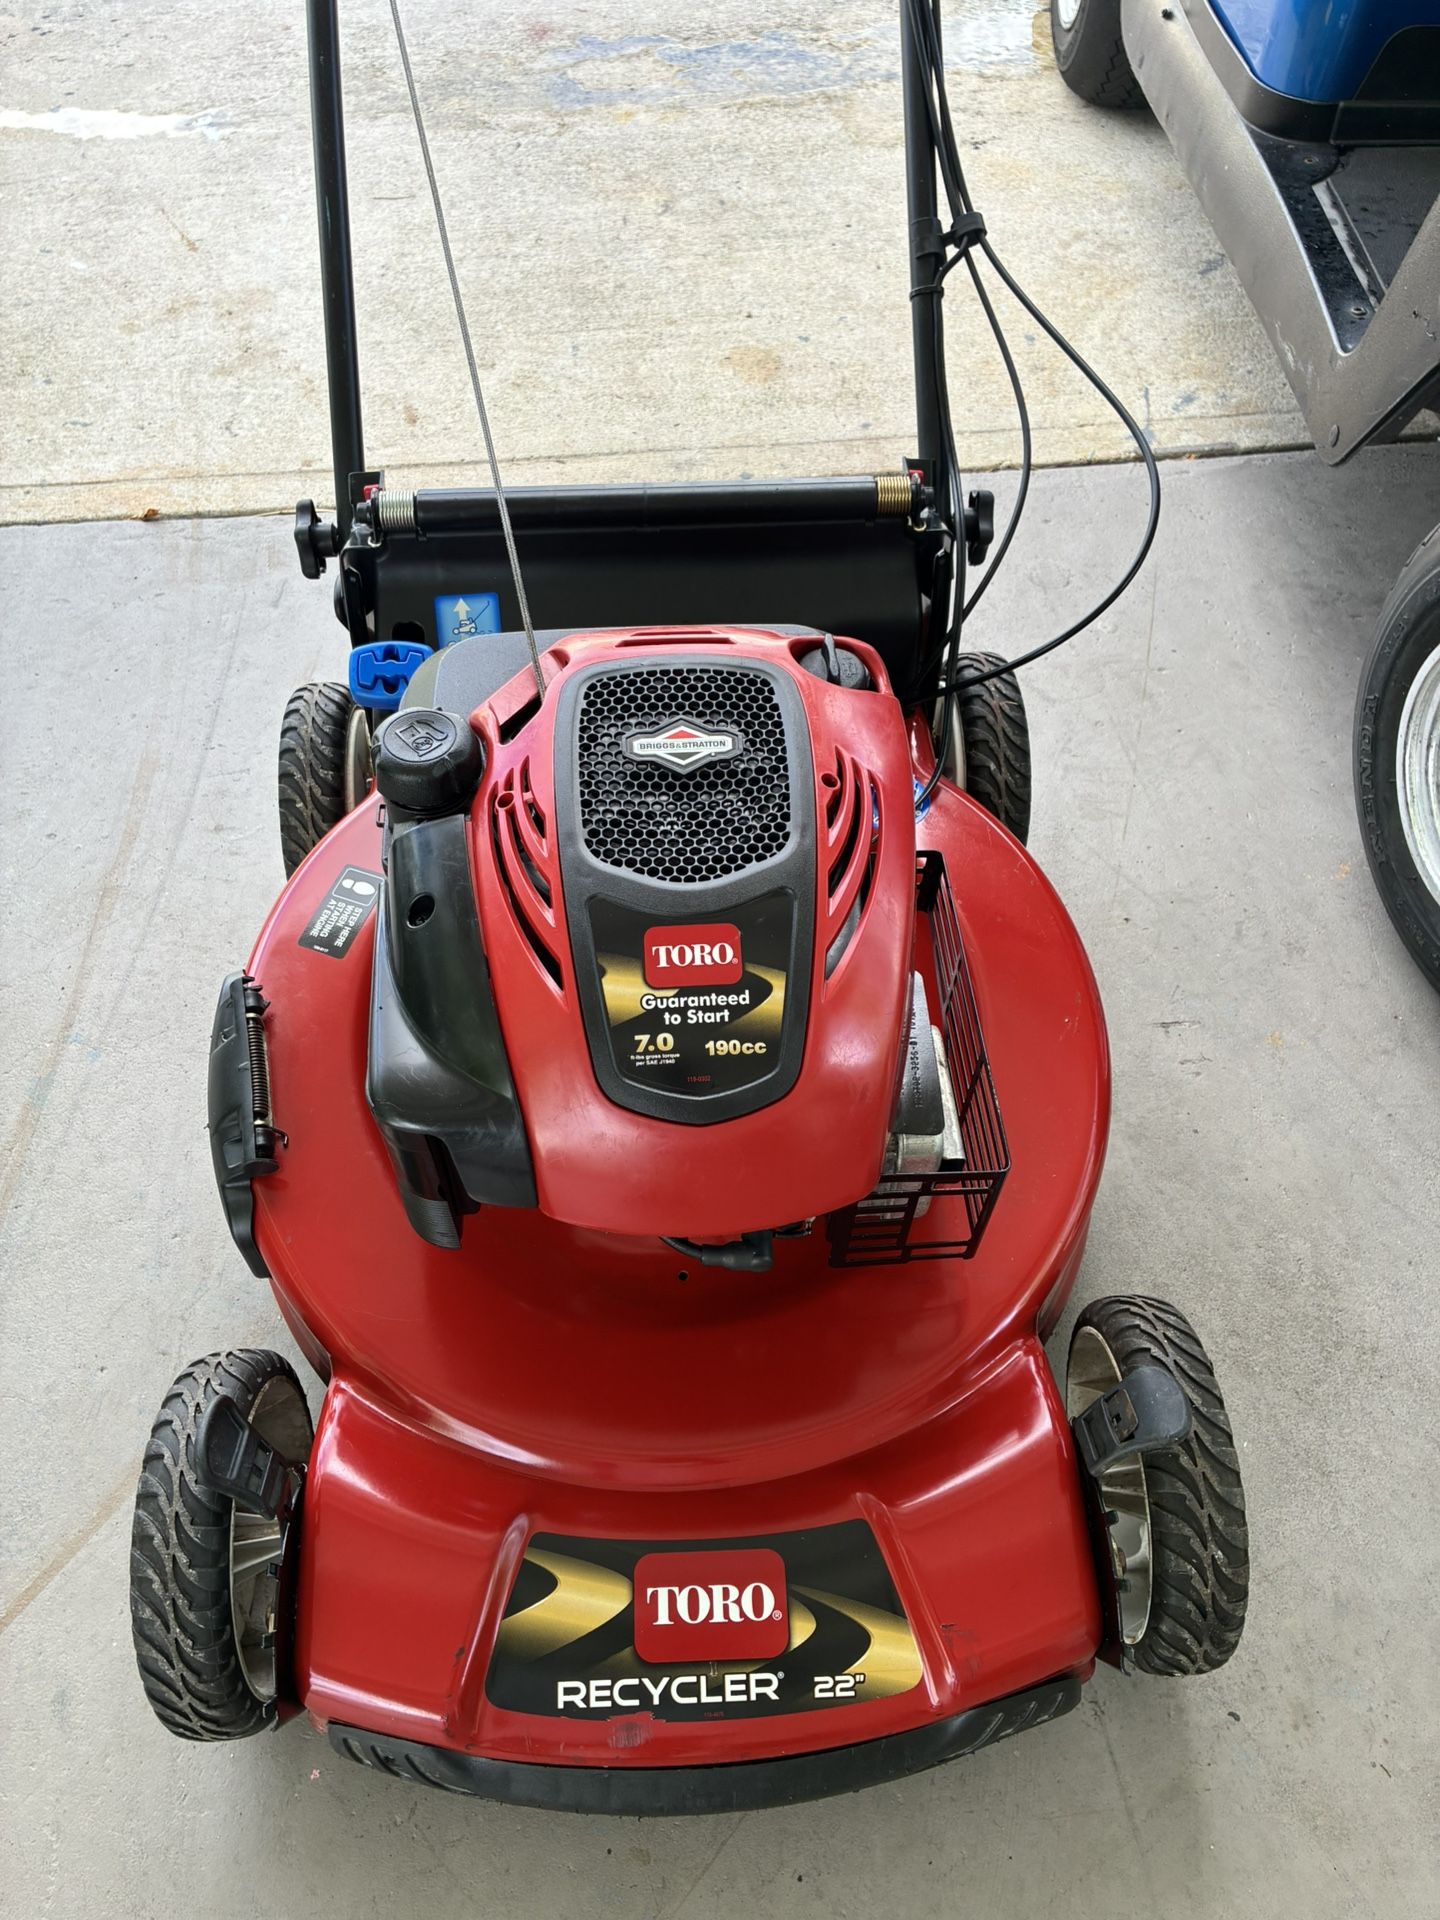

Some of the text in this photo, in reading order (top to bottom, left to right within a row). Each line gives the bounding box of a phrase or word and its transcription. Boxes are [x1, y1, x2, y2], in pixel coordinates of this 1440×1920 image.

[327, 898, 337, 911] AT
[336, 905, 355, 927] WHEN
[309, 909, 332, 938] ENGINE
[319, 901, 346, 938] STARTING
[334, 907, 363, 948] STEP HERE
[652, 942, 734, 968] TORO
[641, 990, 750, 1010] Guaranteed
[664, 1009, 730, 1025] to Start
[634, 1032, 675, 1053] 7.0
[704, 1040, 767, 1056] 190cc
[647, 1582, 775, 1626] TORO
[557, 1673, 864, 1709] RECYCLER 22"
